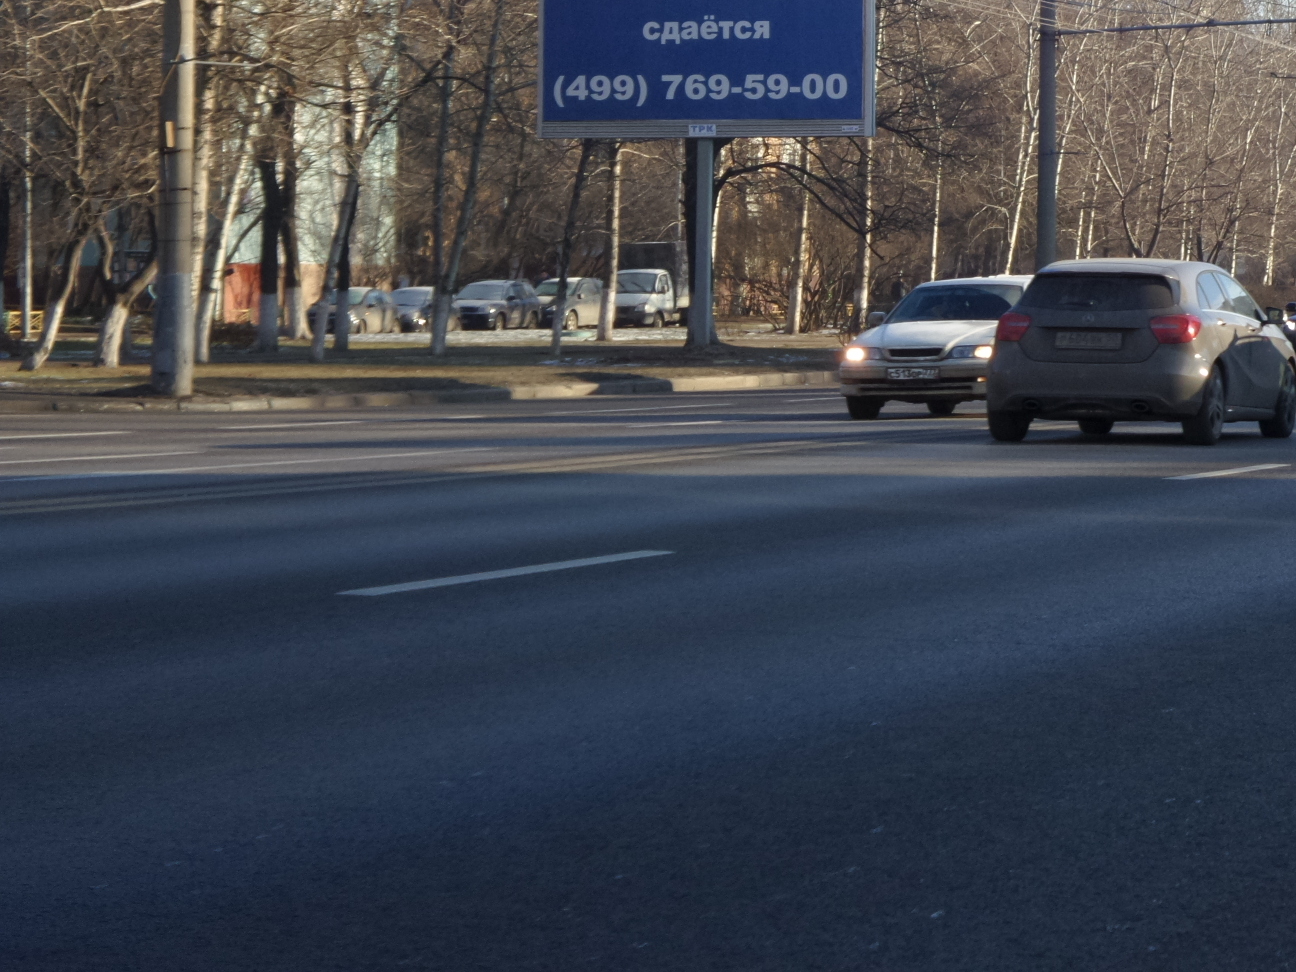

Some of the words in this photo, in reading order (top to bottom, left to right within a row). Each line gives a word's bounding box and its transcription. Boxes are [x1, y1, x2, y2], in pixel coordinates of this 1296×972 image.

[642, 15, 771, 44] сдаётся
[553, 74, 648, 107] (499)
[661, 73, 849, 100] 769-59-00
